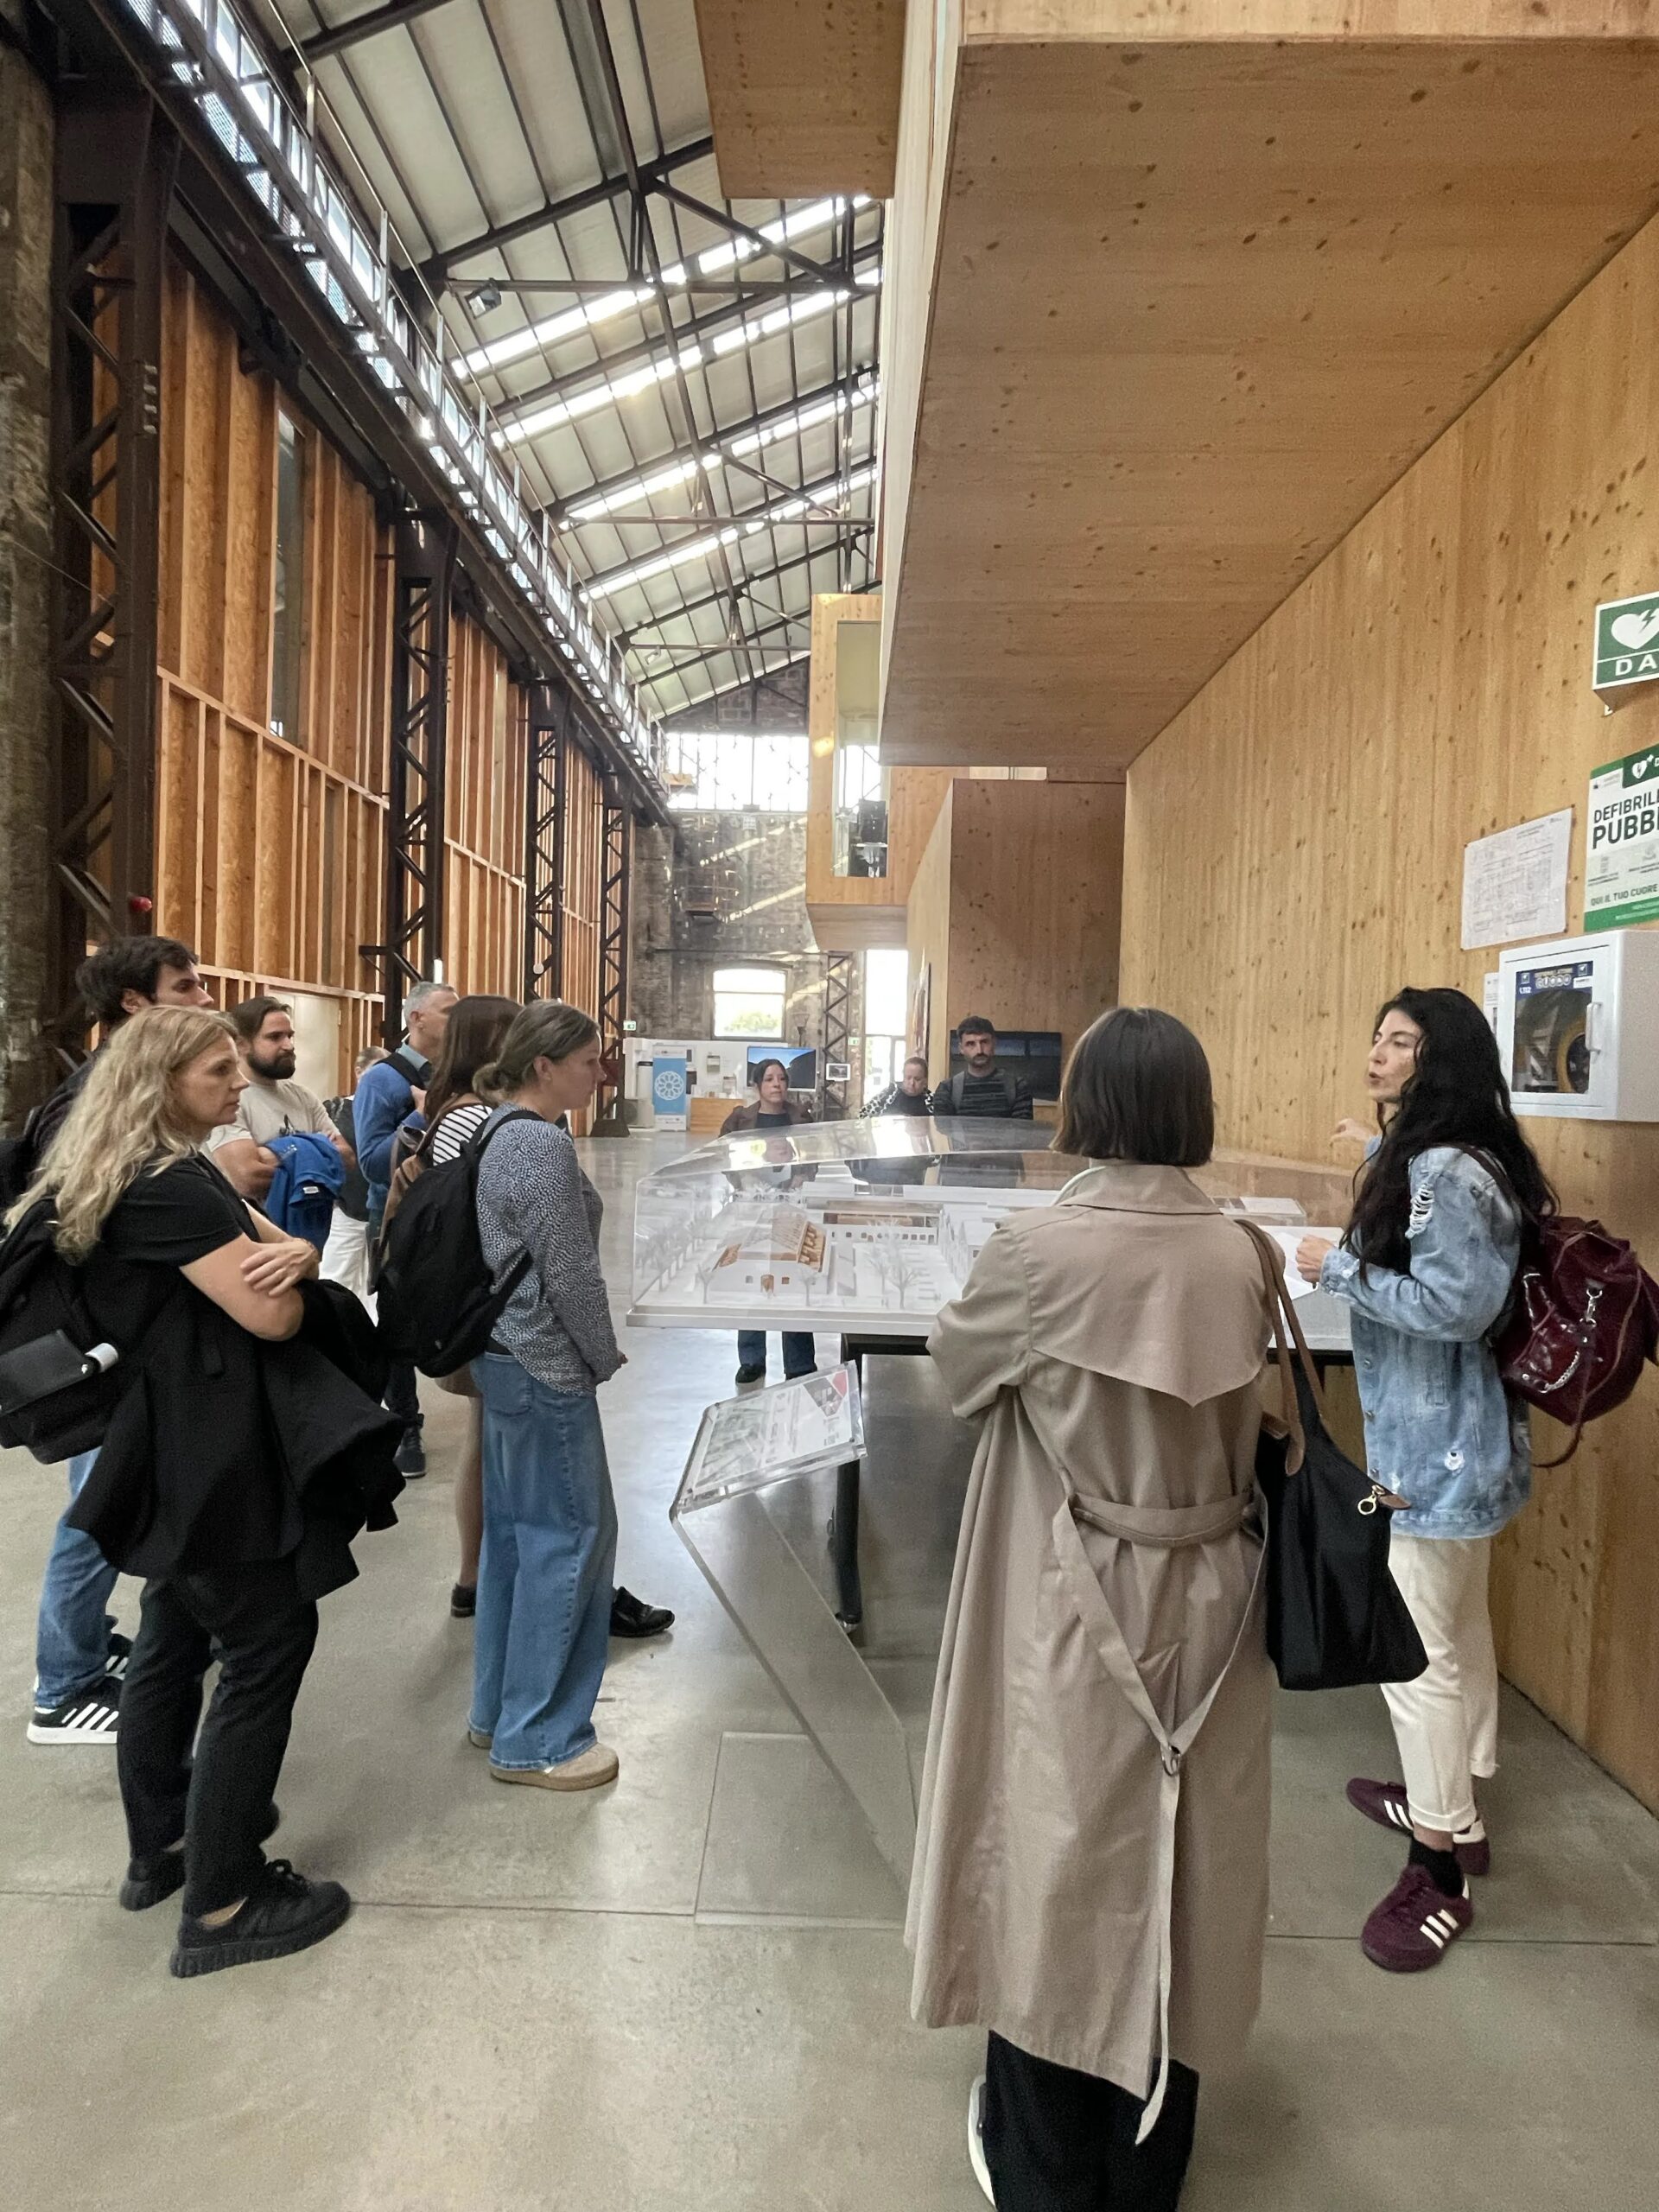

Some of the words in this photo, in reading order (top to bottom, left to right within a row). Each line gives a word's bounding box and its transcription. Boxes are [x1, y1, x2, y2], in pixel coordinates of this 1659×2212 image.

[1592, 806, 1659, 849] PUBB
[1605, 893, 1611, 903] IL
[1613, 890, 1630, 901] TUO
[1630, 883, 1658, 897] CUORE
